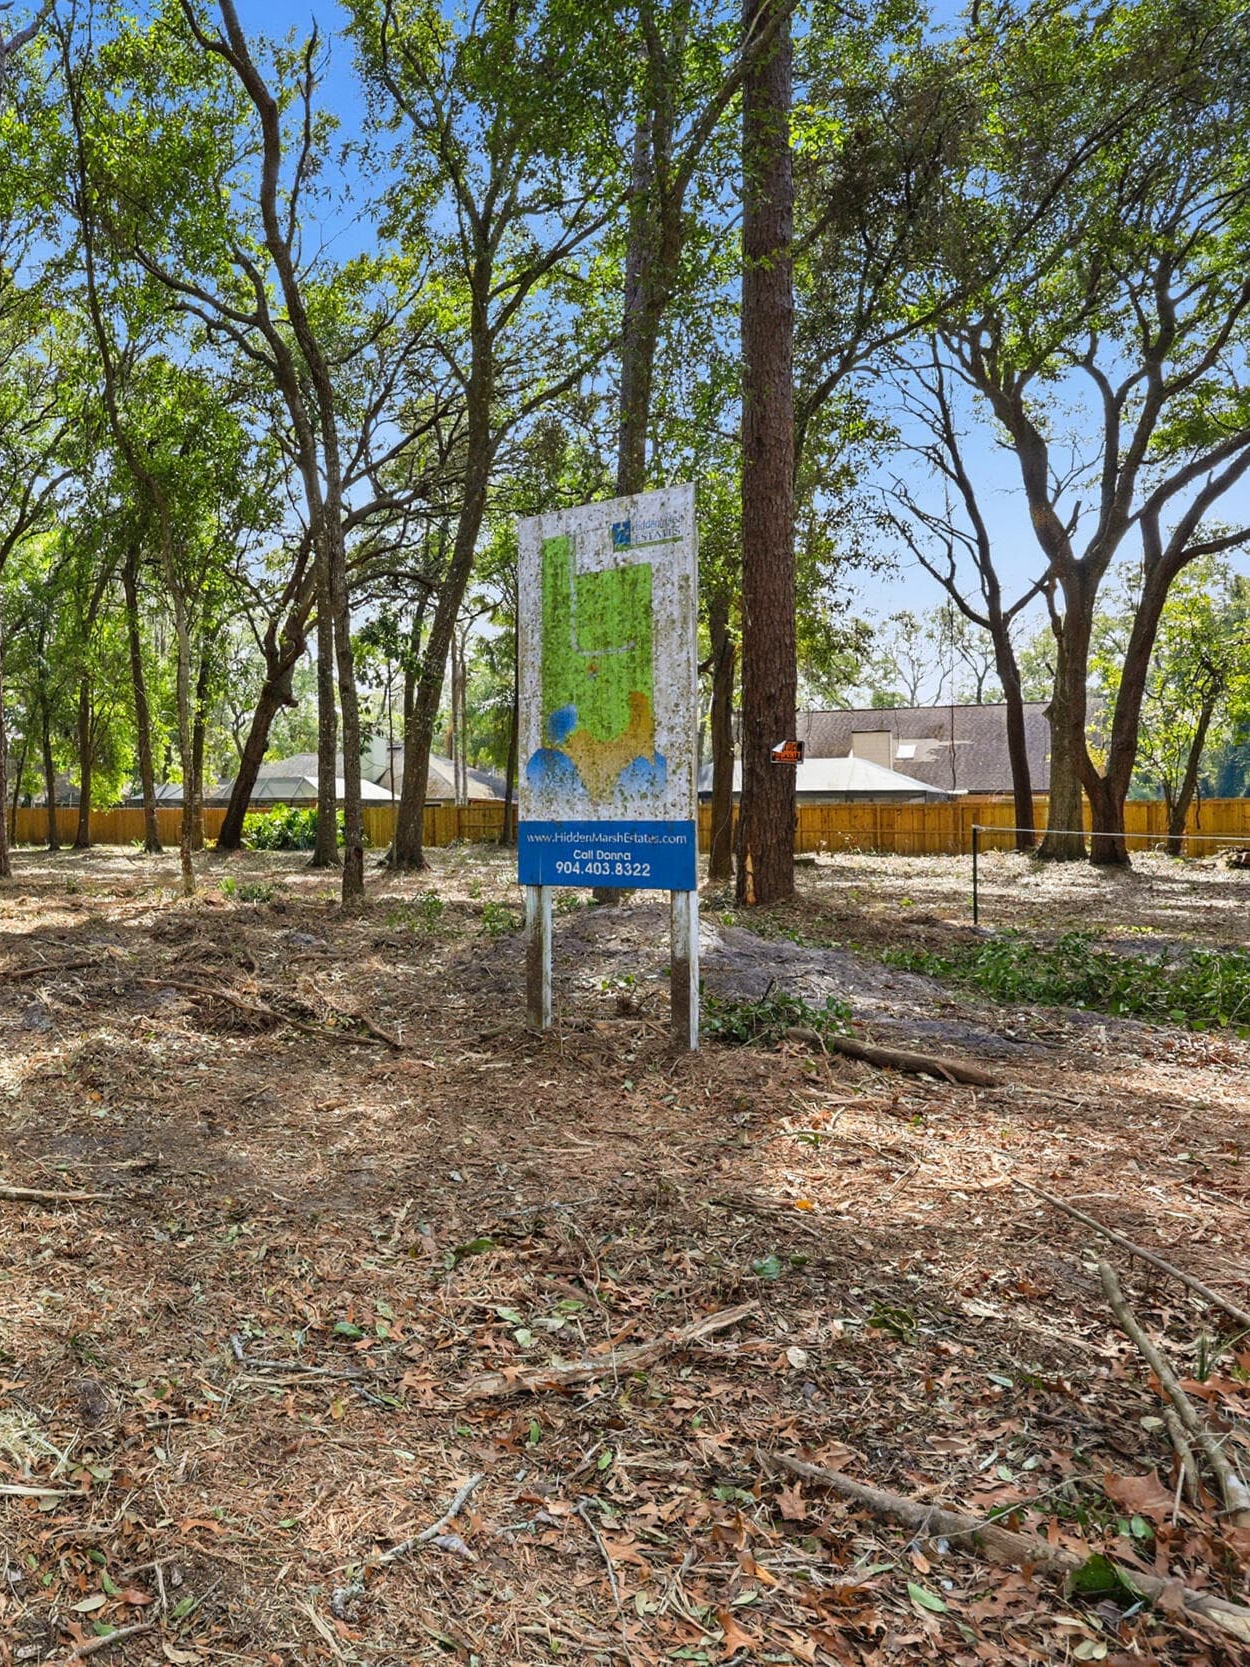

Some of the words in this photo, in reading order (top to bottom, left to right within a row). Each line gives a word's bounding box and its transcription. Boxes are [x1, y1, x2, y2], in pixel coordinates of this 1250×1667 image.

[526, 831, 687, 845] www.HiddenMarshEstates.com
[573, 849, 594, 860] Call
[596, 850, 631, 861] Donna
[555, 861, 651, 877] 904.403.8322
